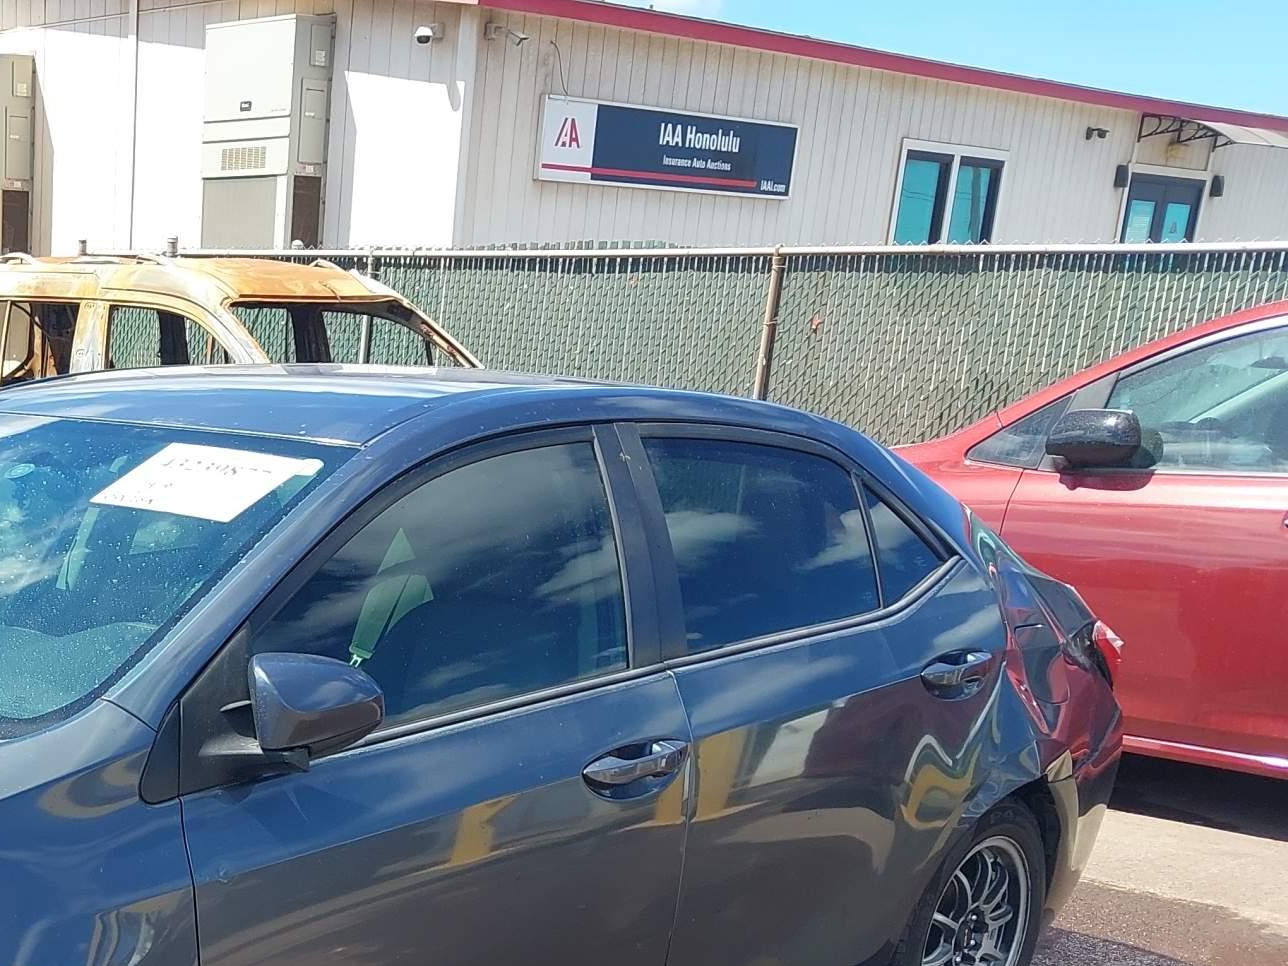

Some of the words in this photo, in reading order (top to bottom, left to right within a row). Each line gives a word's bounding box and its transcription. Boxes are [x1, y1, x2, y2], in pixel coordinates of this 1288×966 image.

[659, 122, 682, 147] IAA
[685, 125, 740, 153] Honolulu
[663, 154, 691, 167] Insurance
[692, 157, 706, 169] Auto
[706, 159, 732, 172] Auctions
